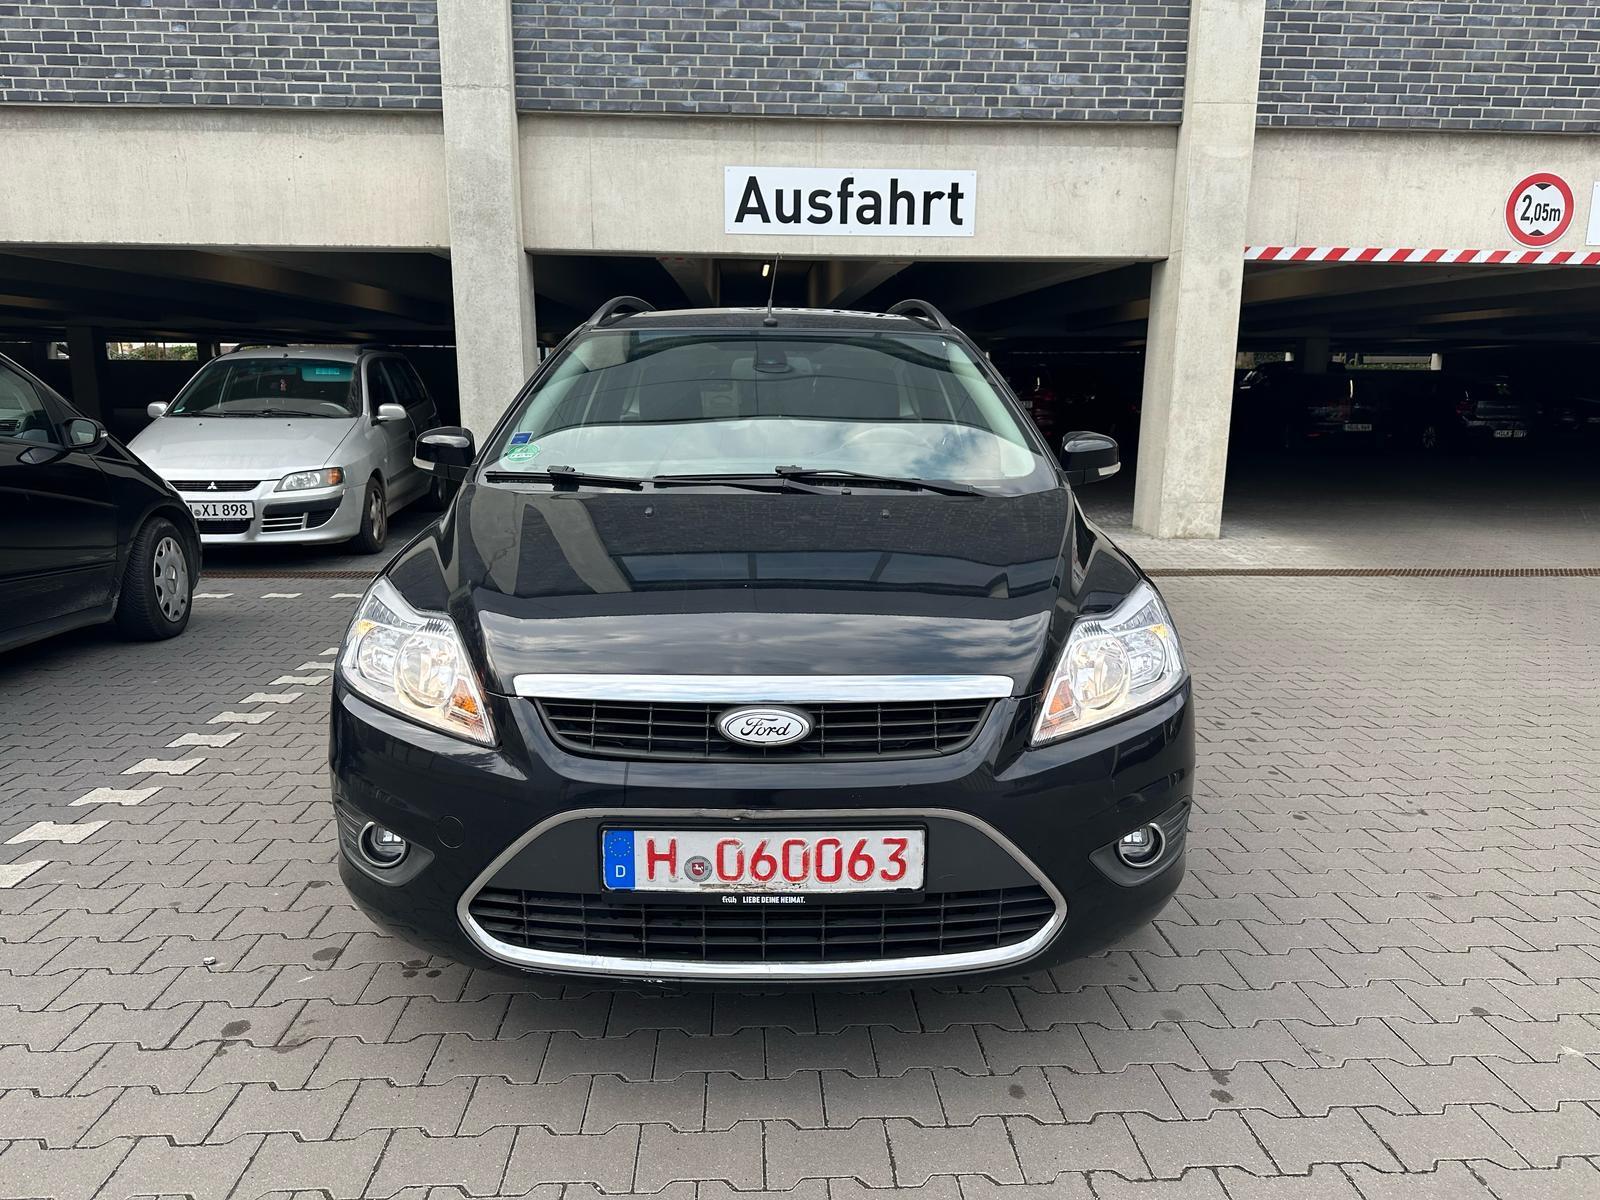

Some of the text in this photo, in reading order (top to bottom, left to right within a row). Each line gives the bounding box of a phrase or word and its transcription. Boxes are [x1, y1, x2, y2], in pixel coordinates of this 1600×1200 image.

[734, 175, 965, 226] Ausfahrt
[1520, 194, 1561, 225] 2,05m
[202, 504, 219, 516] XI
[222, 504, 248, 516] 898
[740, 717, 792, 736] Ford
[646, 837, 677, 882] H
[715, 837, 909, 882] 060063
[615, 864, 627, 878] D
[742, 895, 806, 904] LIEBE DEINE HEIMAT.
